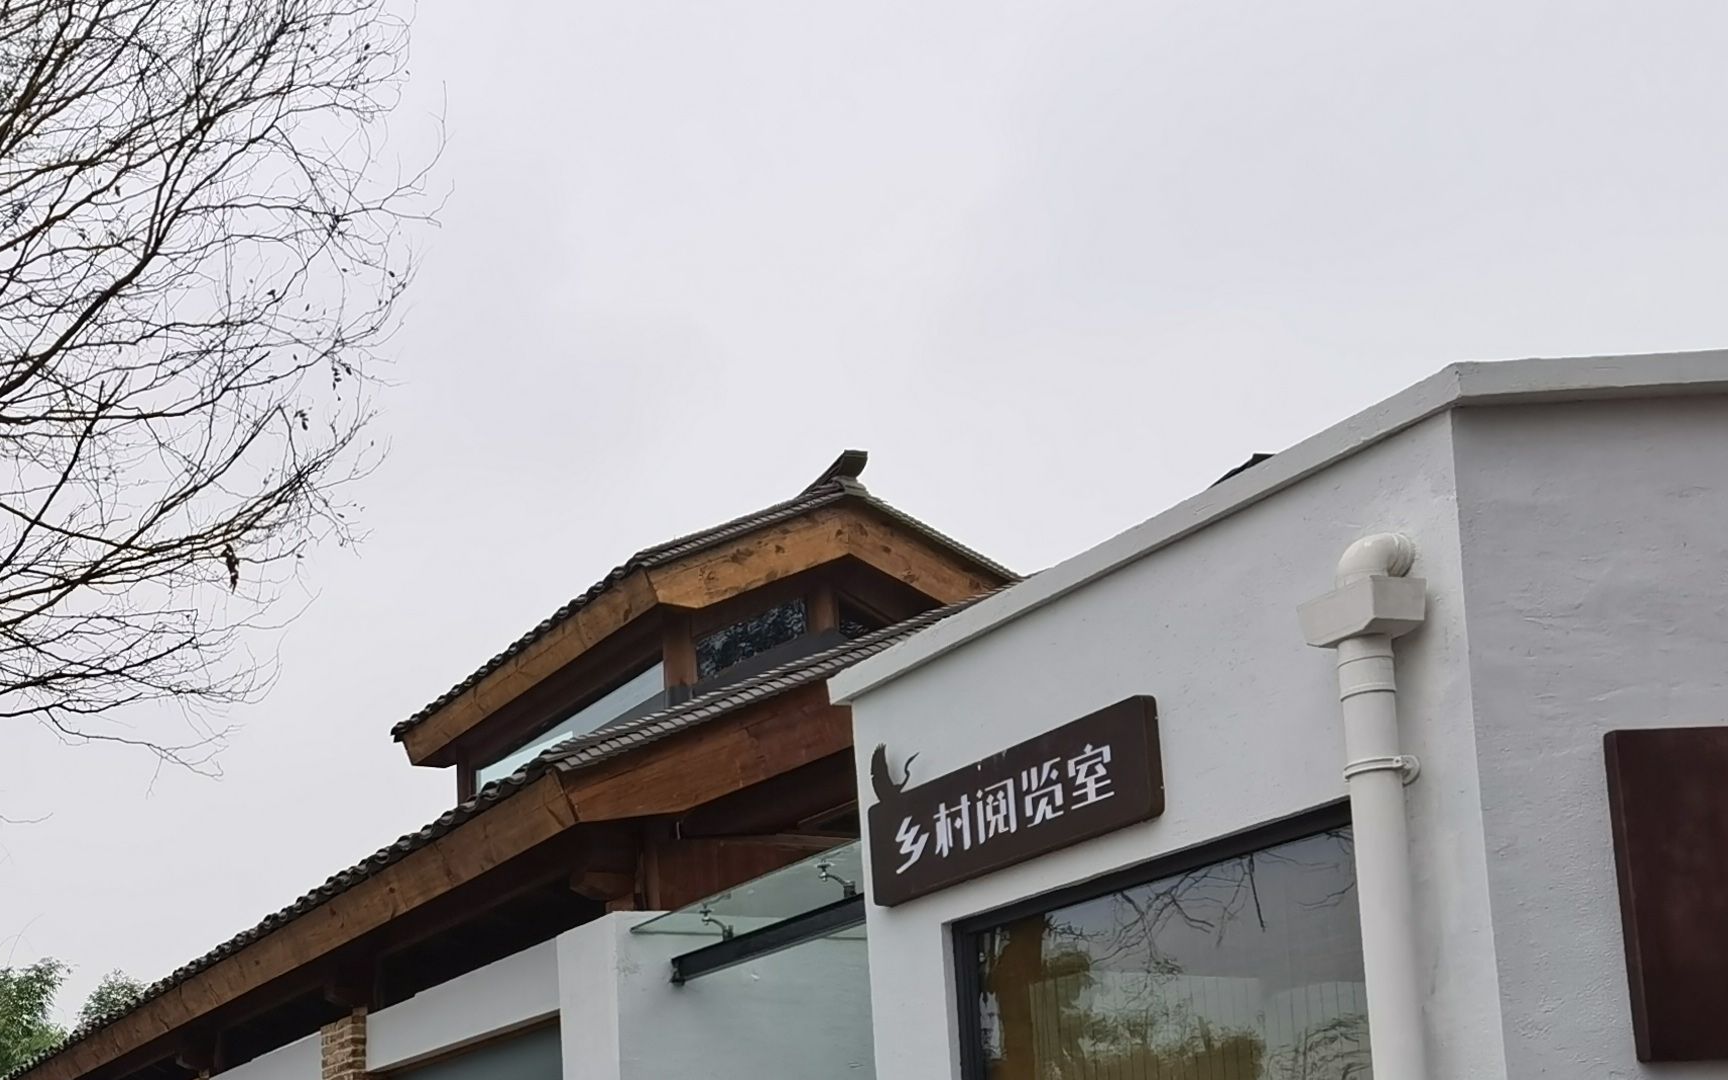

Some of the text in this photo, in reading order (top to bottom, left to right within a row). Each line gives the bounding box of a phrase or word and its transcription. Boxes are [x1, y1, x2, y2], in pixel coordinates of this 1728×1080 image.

[895, 743, 1115, 875] 乡村阅览室
